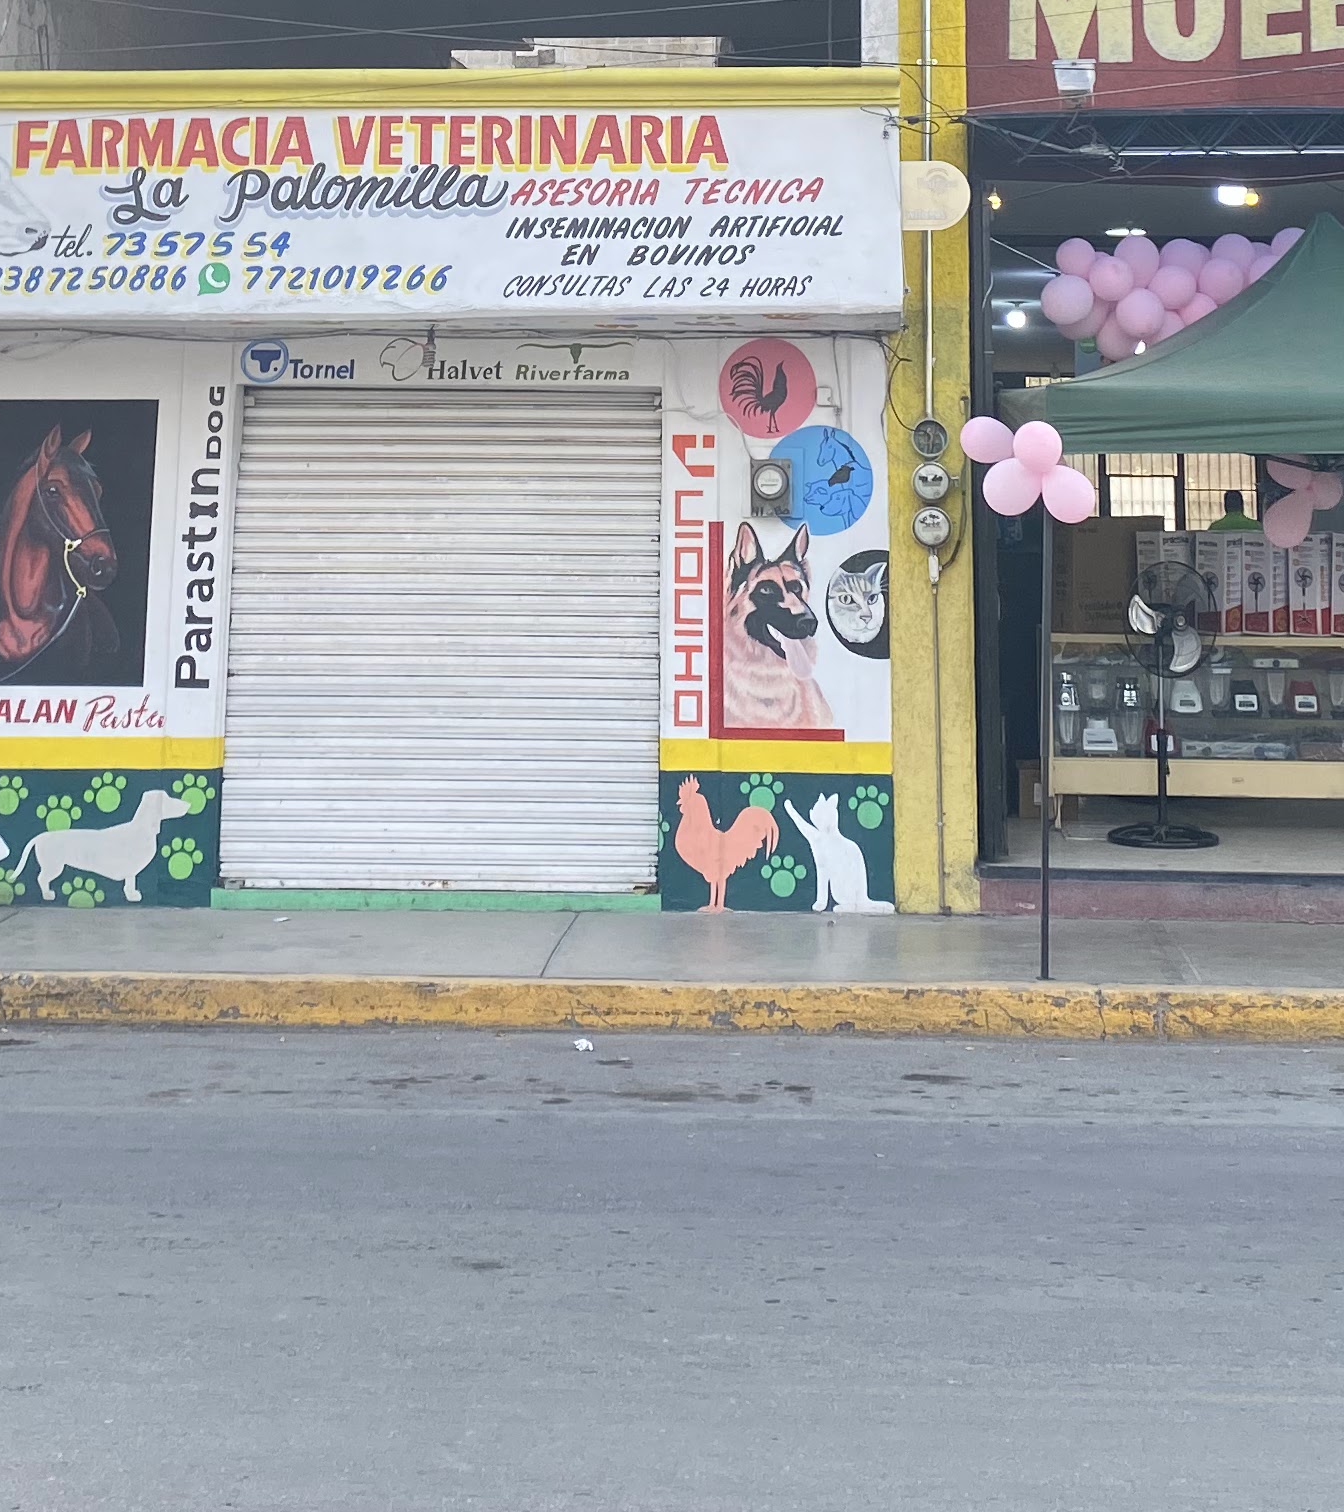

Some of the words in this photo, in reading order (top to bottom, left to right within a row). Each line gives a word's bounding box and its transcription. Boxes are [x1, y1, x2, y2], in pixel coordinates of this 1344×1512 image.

[12, 115, 315, 173] FARMACIA
[338, 114, 729, 169] VETERINARIA
[103, 166, 190, 226] La
[218, 162, 508, 224] Palomilla
[510, 178, 660, 206] ASESORIA
[684, 177, 824, 205] TECNICA
[50, 223, 93, 258] tel.
[505, 216, 692, 239] INSEMINACION
[561, 243, 600, 267] EN
[627, 243, 755, 267] BOVINOS
[245, 264, 453, 292] 7721019266
[503, 274, 632, 299] CONSULTAS
[643, 275, 692, 299] LAS
[700, 276, 730, 298] 24
[739, 274, 813, 299] HORAS
[290, 358, 355, 380] Tornel
[427, 359, 503, 381] Halvet
[516, 364, 630, 381] Riverfarma
[83, 694, 167, 732] Pasta
